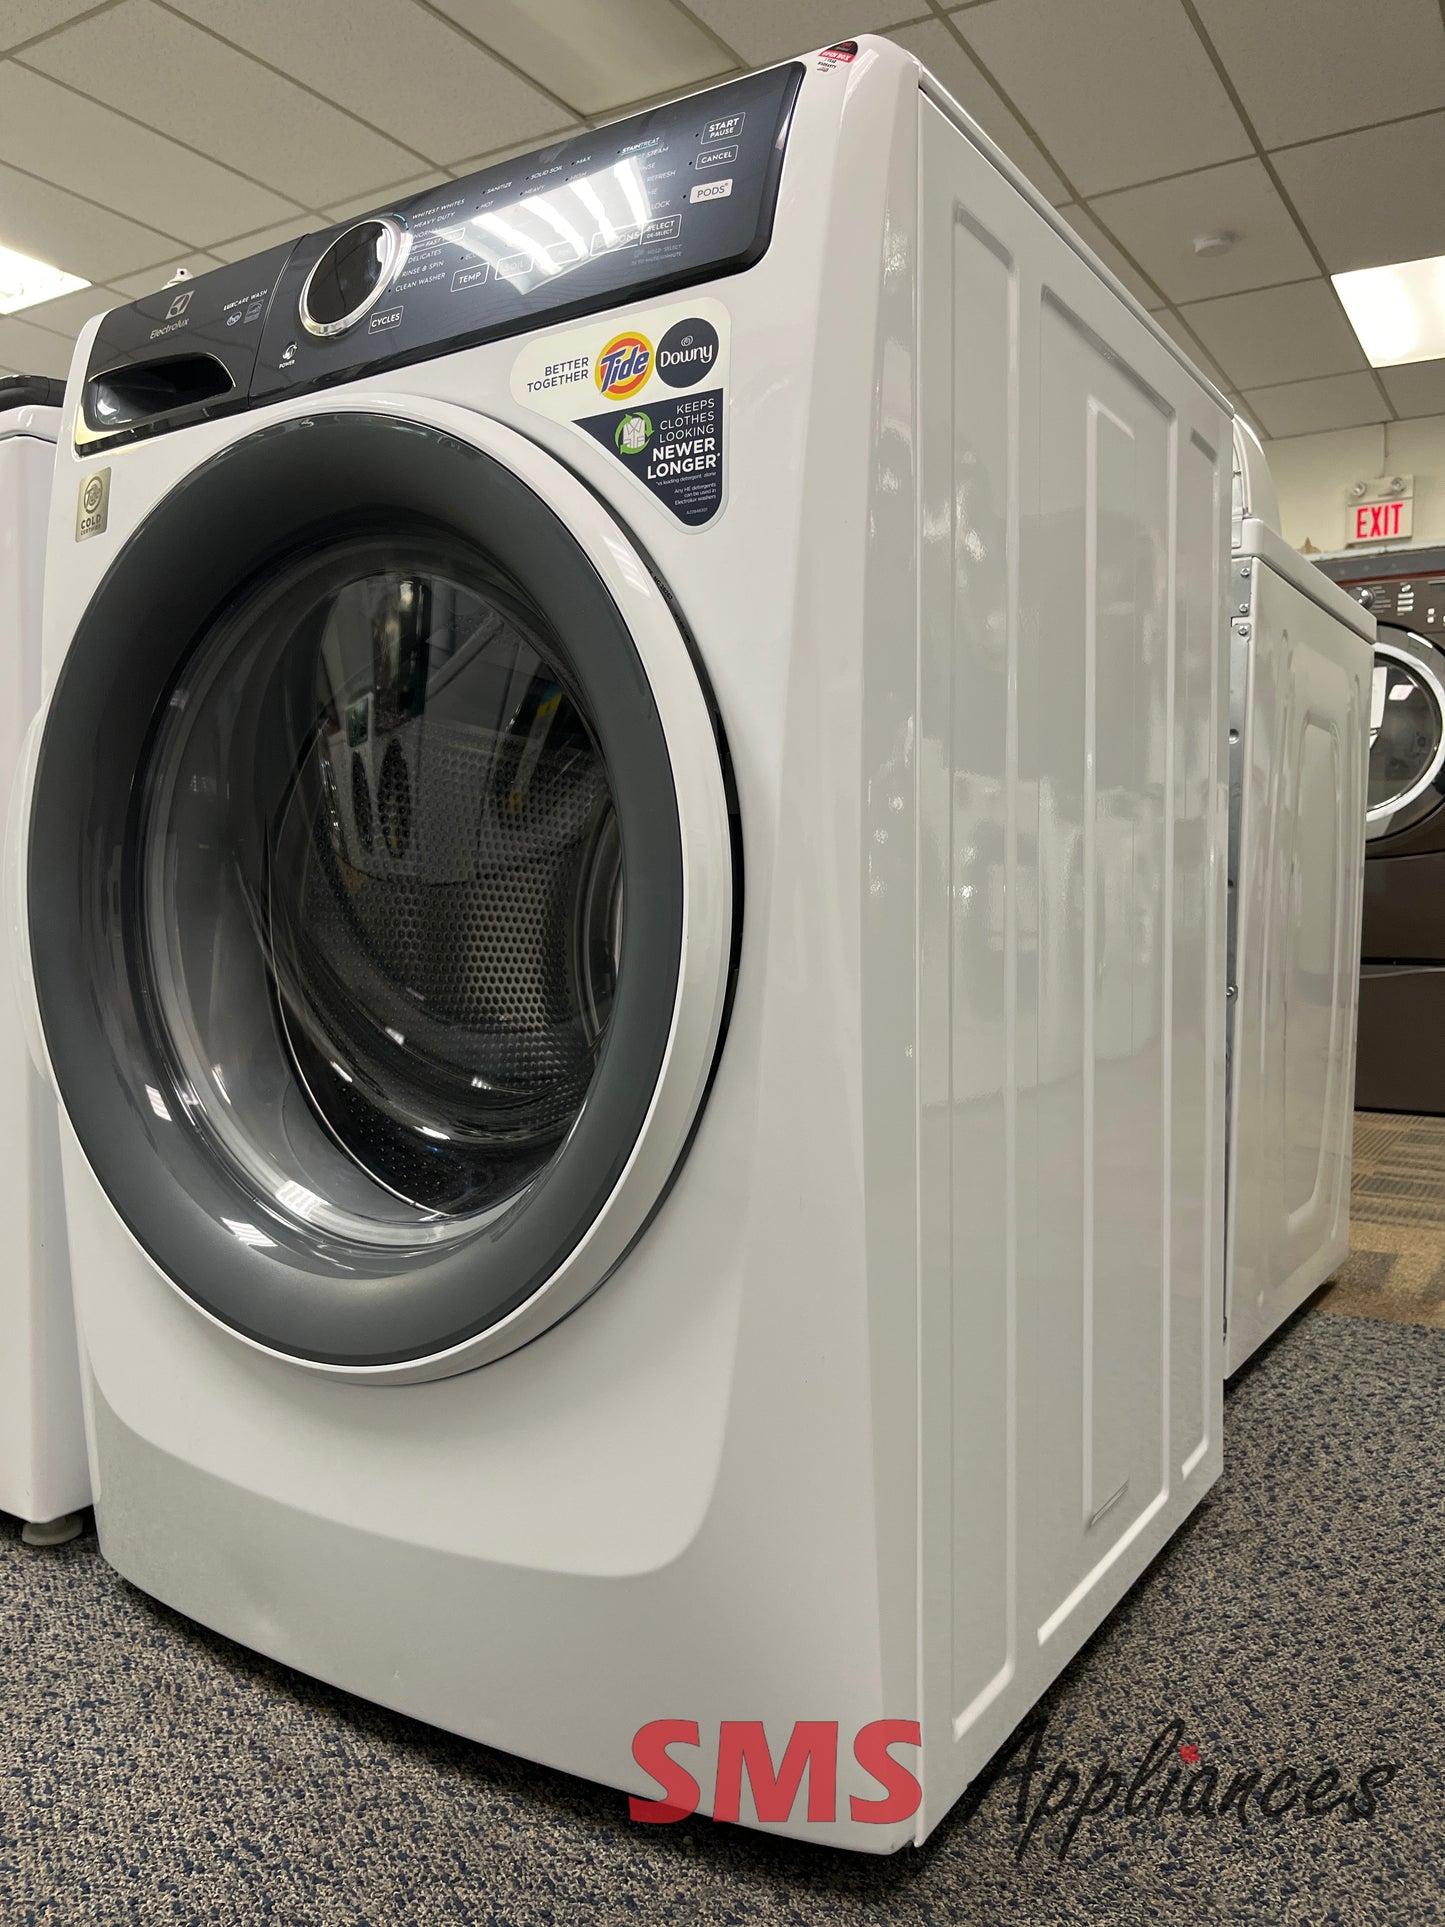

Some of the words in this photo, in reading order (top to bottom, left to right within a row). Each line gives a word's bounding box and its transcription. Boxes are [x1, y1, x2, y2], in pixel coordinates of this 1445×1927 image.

[708, 118, 740, 132] START
[710, 127, 735, 138] PAUSE
[701, 151, 733, 164] CANCEL
[487, 182, 512, 194] SANITIZE
[524, 185, 546, 195] HEAVY
[412, 206, 440, 220] WHITEST
[440, 198, 465, 211] WHITES
[414, 219, 436, 229] HEAVY
[436, 212, 456, 222] DUTY
[646, 220, 675, 232] SELECT
[646, 229, 673, 239] DE-SELECT
[408, 249, 442, 264] DELICATES
[402, 266, 420, 278] RINSE
[428, 260, 444, 270] SPIN
[395, 281, 417, 292] CLEAN
[418, 272, 446, 285] WASHER
[459, 272, 482, 284] TEMP
[372, 312, 400, 328] CYCLES
[150, 318, 190, 340] Electrolux
[279, 359, 296, 369] POWER
[660, 344, 713, 368] Downy
[544, 356, 589, 376] BETTER
[600, 343, 650, 394] Tide
[527, 369, 588, 393] TOGETHER
[676, 398, 714, 414] KEEPS
[660, 410, 714, 430] CLOTHES
[660, 424, 714, 444] LOOKING
[652, 437, 716, 462] NEWER
[680, 474, 702, 482] detergent
[692, 482, 717, 491] detergents
[81, 514, 102, 530] COLD
[1356, 504, 1404, 539] EXIT
